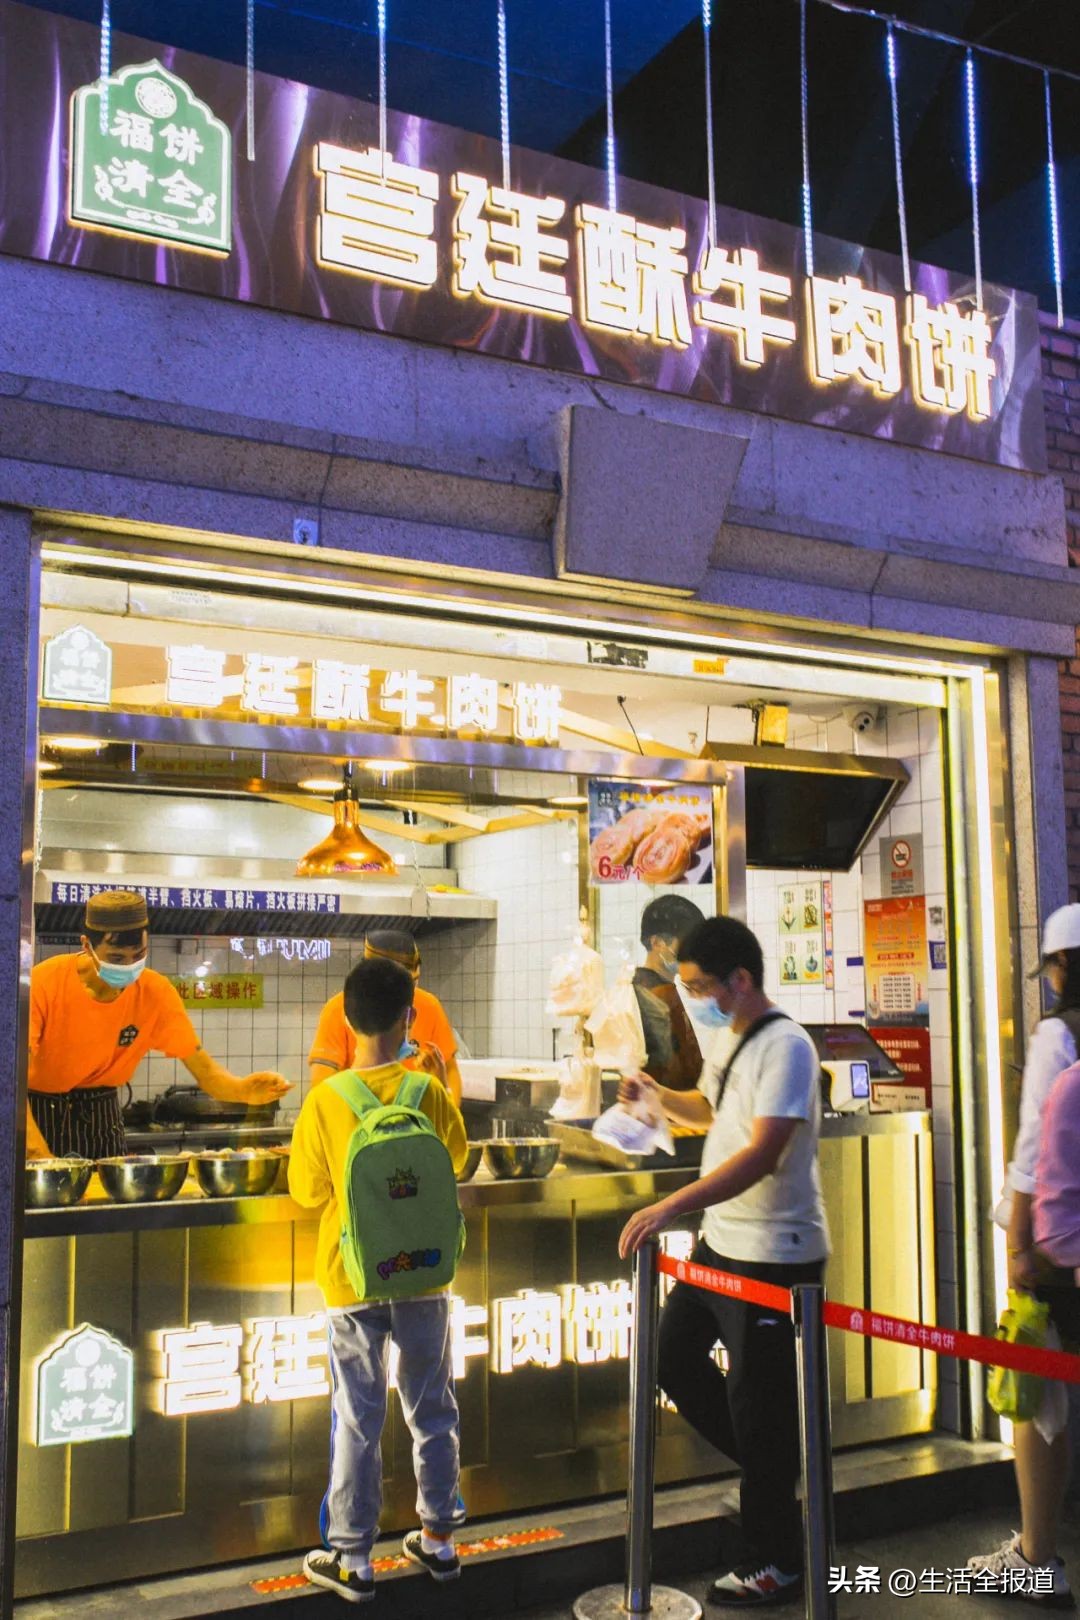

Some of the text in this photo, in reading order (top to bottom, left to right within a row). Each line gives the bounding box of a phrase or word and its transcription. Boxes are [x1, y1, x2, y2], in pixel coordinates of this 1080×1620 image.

[314, 142, 998, 422] 宫廷酥牛肉饼
[165, 643, 563, 742] 宫廷酥牛肉饼
